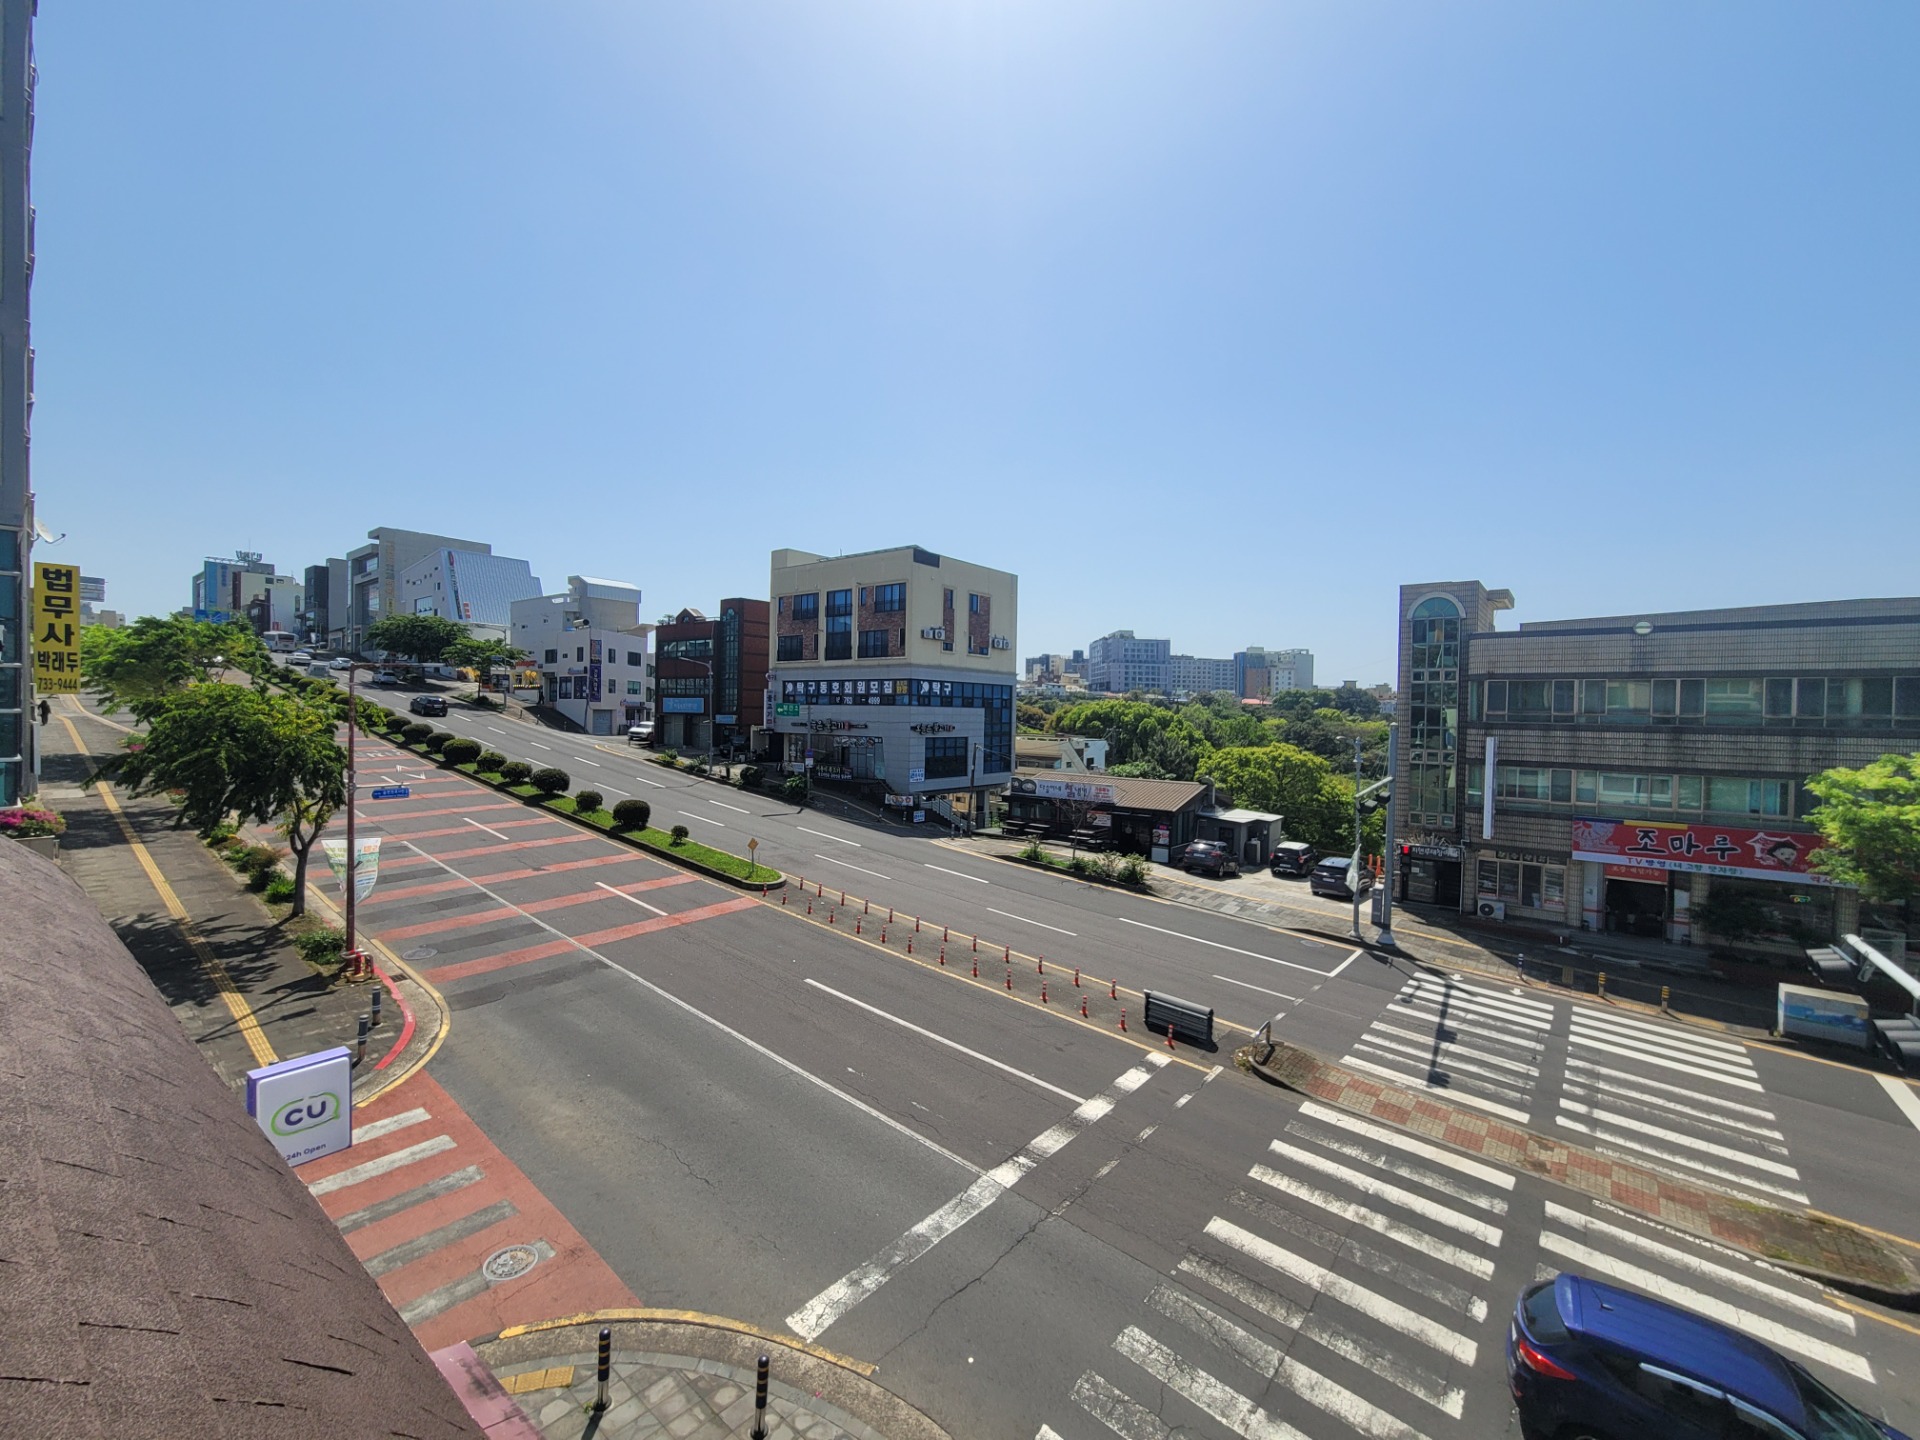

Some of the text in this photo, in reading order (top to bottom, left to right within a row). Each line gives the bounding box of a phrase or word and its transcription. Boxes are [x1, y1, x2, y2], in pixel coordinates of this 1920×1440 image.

[40, 567, 75, 647] 법무사
[37, 651, 78, 673] 박래두
[38, 677, 78, 691] 733-9444
[932, 682, 951, 695] 탁구
[1625, 828, 1742, 862] 조마루
[1626, 857, 1643, 865] TV
[1645, 859, 1666, 868] 방영
[1686, 862, 1703, 872] 고향
[284, 1101, 327, 1126] CU
[286, 1143, 327, 1161] 24h Open
